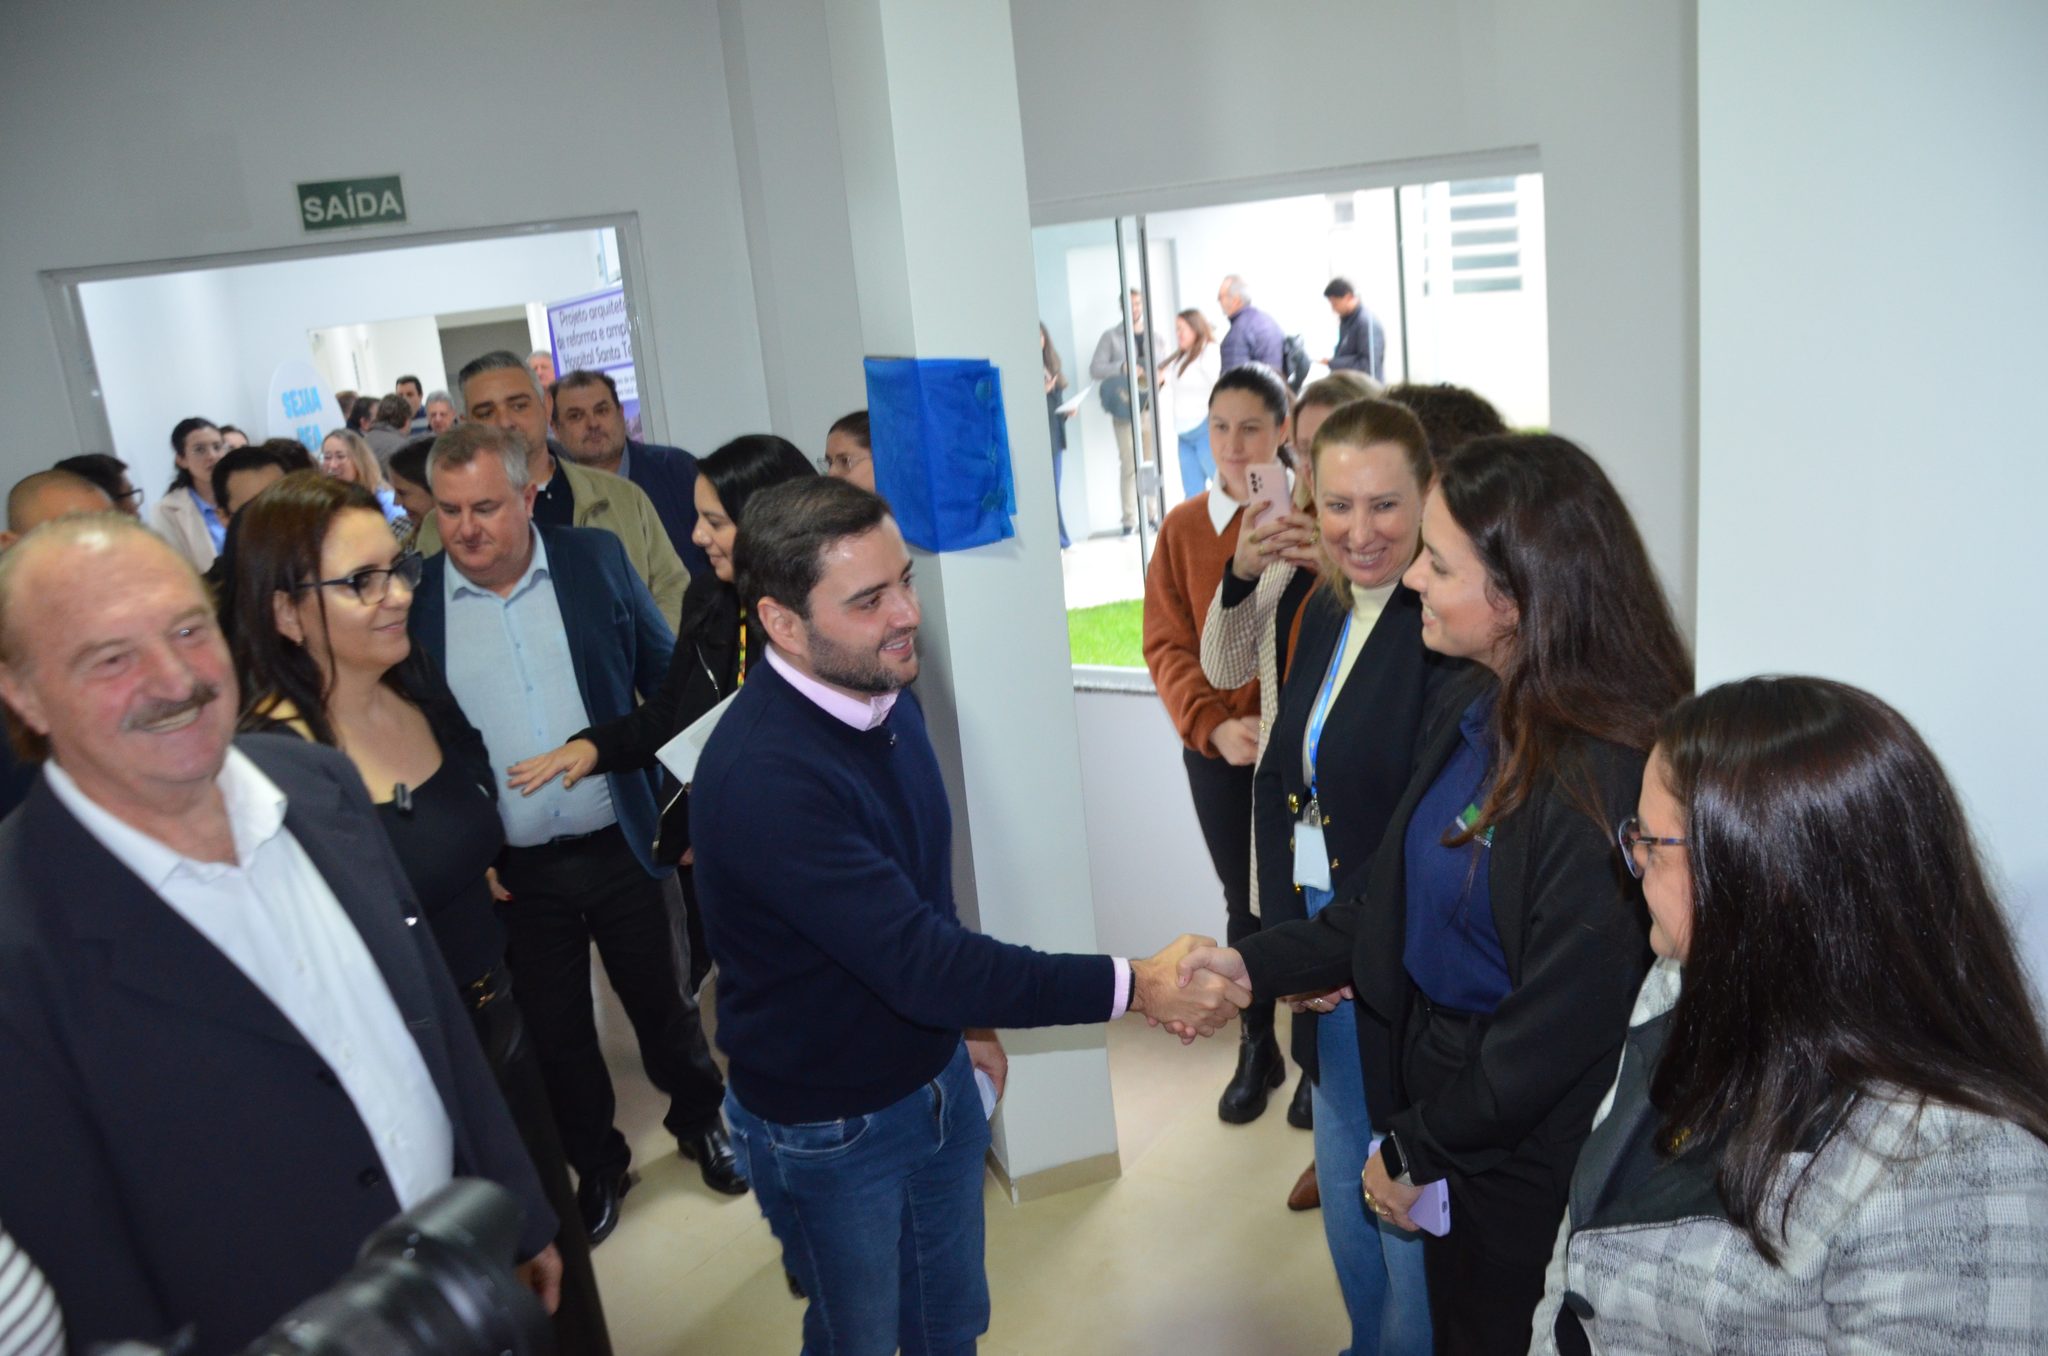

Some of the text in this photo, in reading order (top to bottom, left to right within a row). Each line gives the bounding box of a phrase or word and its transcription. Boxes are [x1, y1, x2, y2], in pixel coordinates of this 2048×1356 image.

[303, 187, 402, 223] SAÍDA
[559, 308, 588, 328] Projeto
[566, 329, 598, 348] reforma
[599, 327, 605, 341] e
[563, 348, 595, 370] Hospital
[595, 346, 621, 362] Santa
